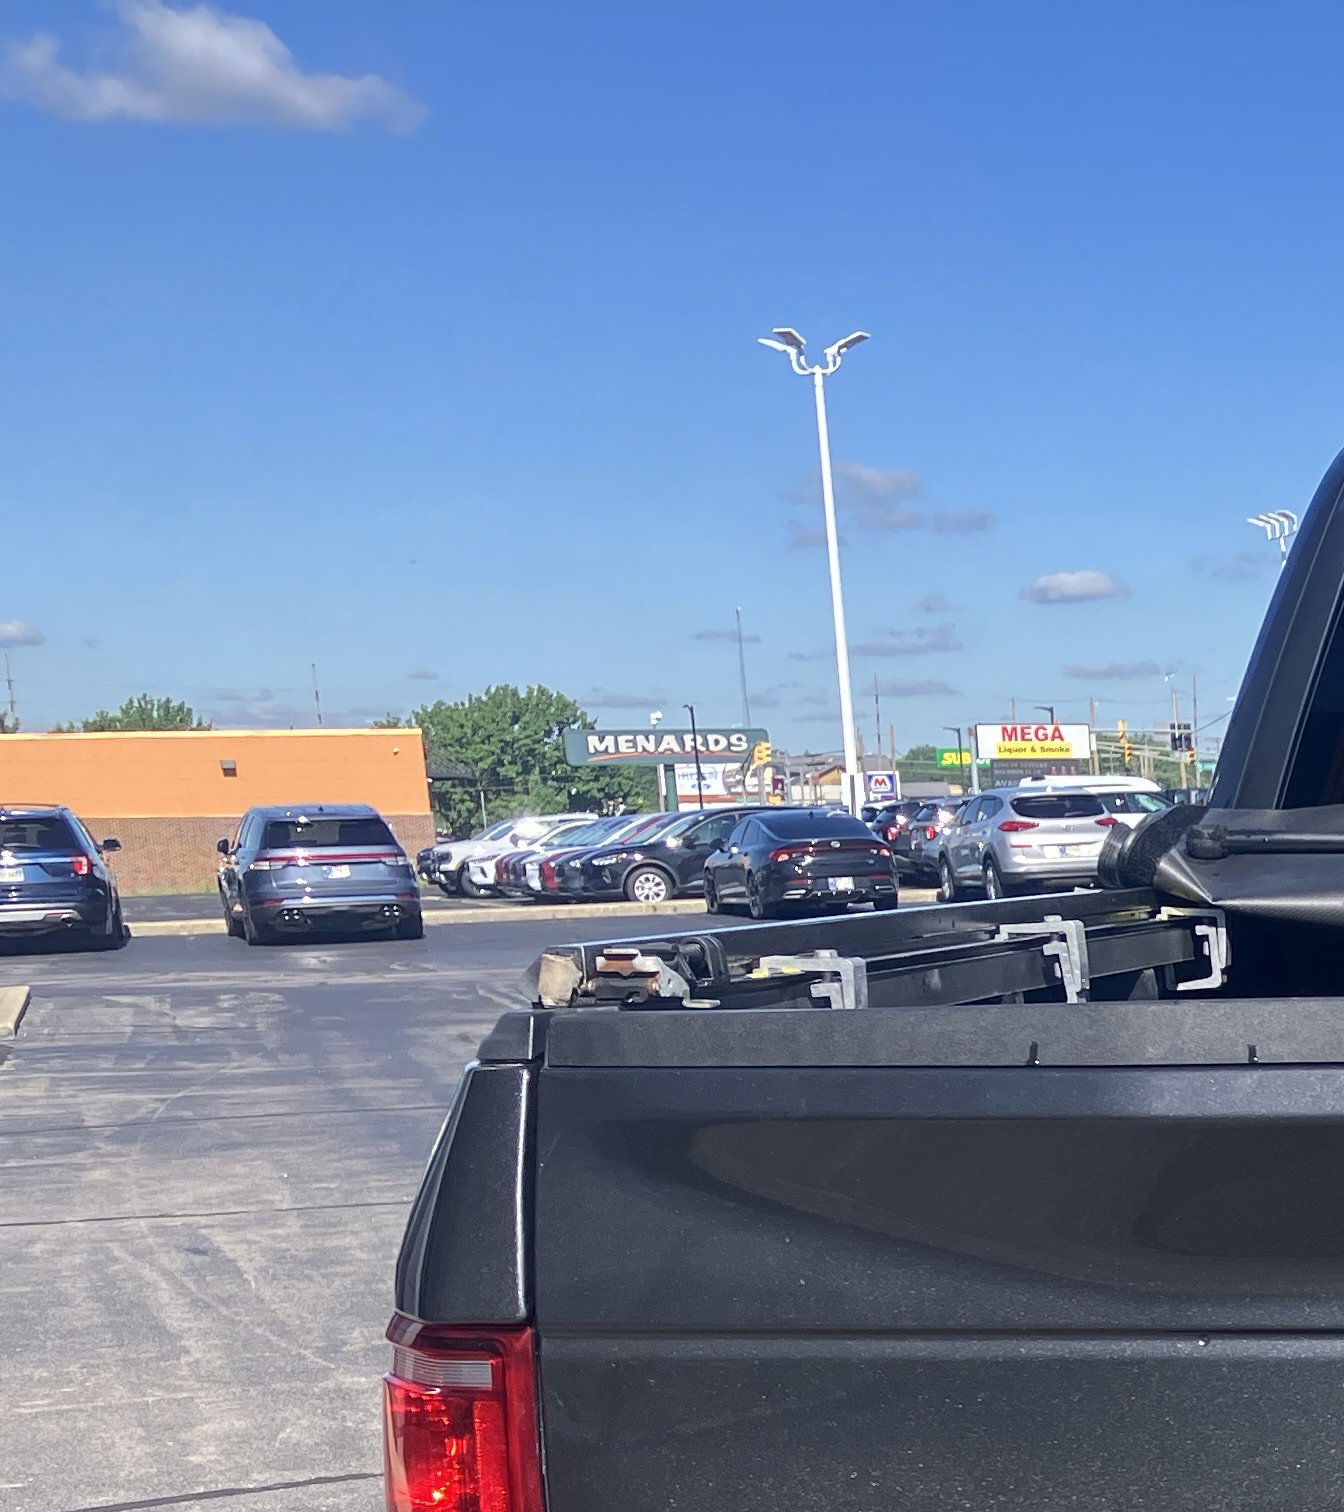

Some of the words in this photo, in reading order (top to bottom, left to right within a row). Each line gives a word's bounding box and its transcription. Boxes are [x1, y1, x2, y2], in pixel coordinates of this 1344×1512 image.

[1001, 725, 1064, 742] MEGA
[586, 733, 748, 754] MENARDS
[998, 746, 1027, 756] Liquor
